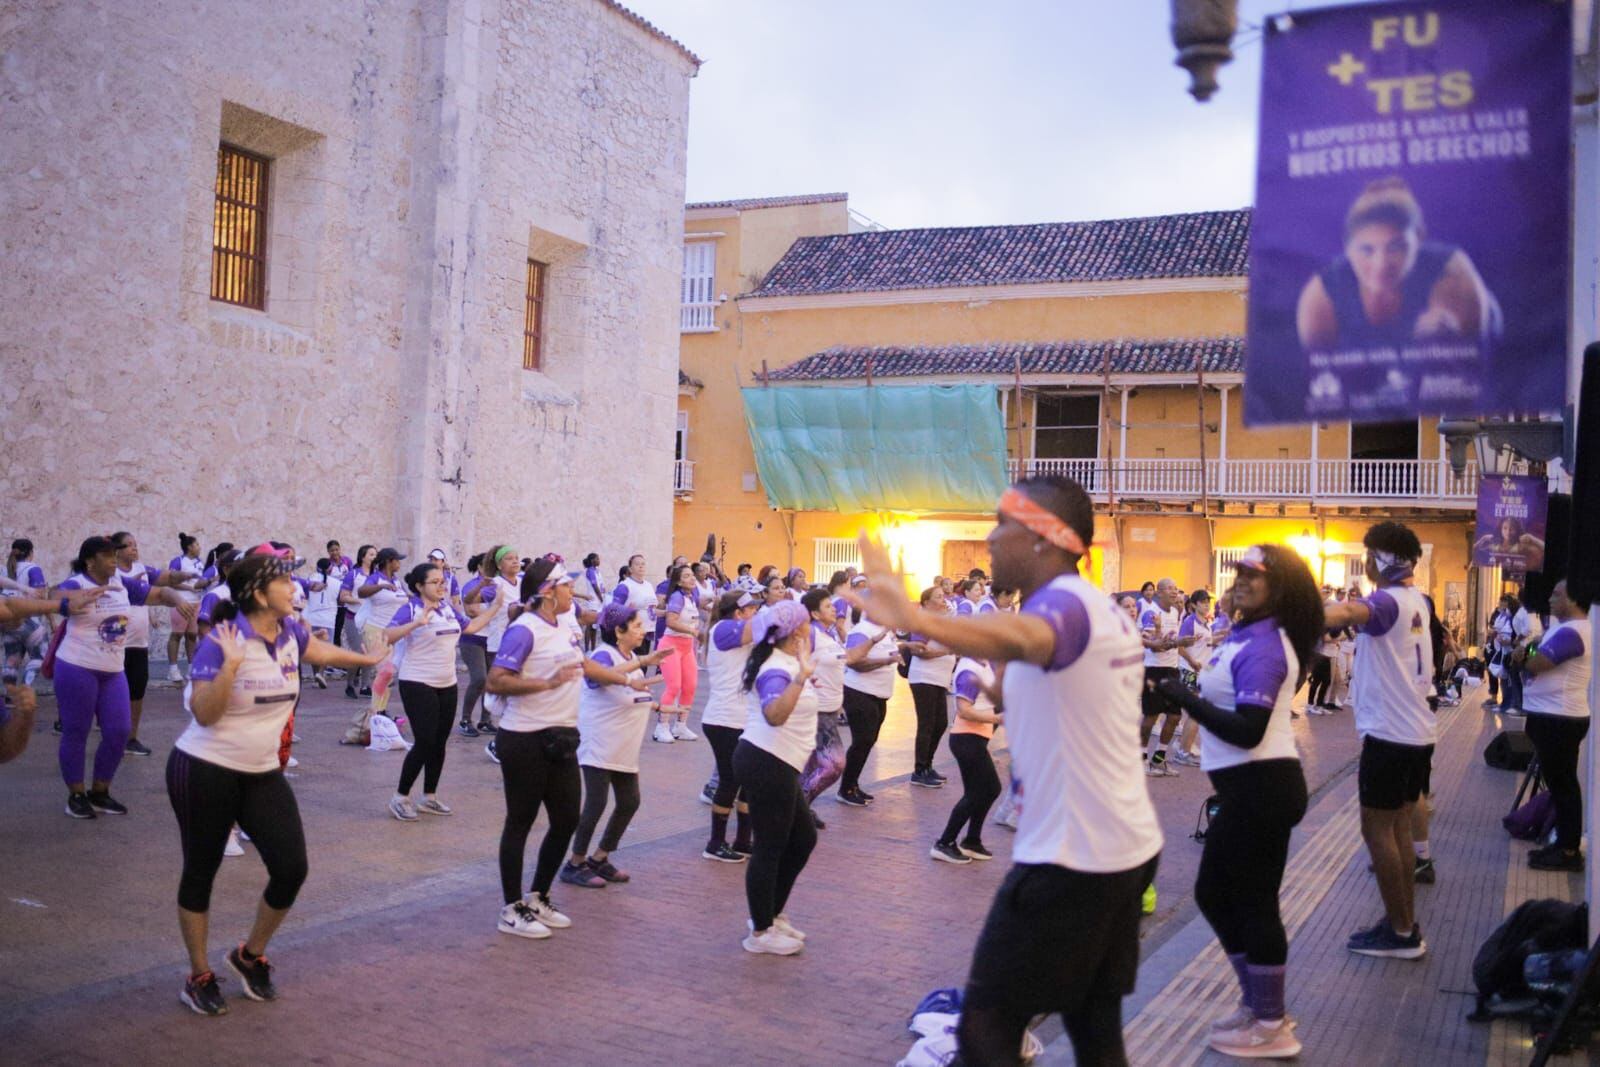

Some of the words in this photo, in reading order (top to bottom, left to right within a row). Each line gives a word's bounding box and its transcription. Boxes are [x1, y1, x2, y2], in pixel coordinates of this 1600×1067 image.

[1371, 12, 1440, 51] FU
[1366, 70, 1475, 114] TES
[1289, 142, 1401, 177] NUESTROS
[1408, 131, 1530, 163] DERECHOS
